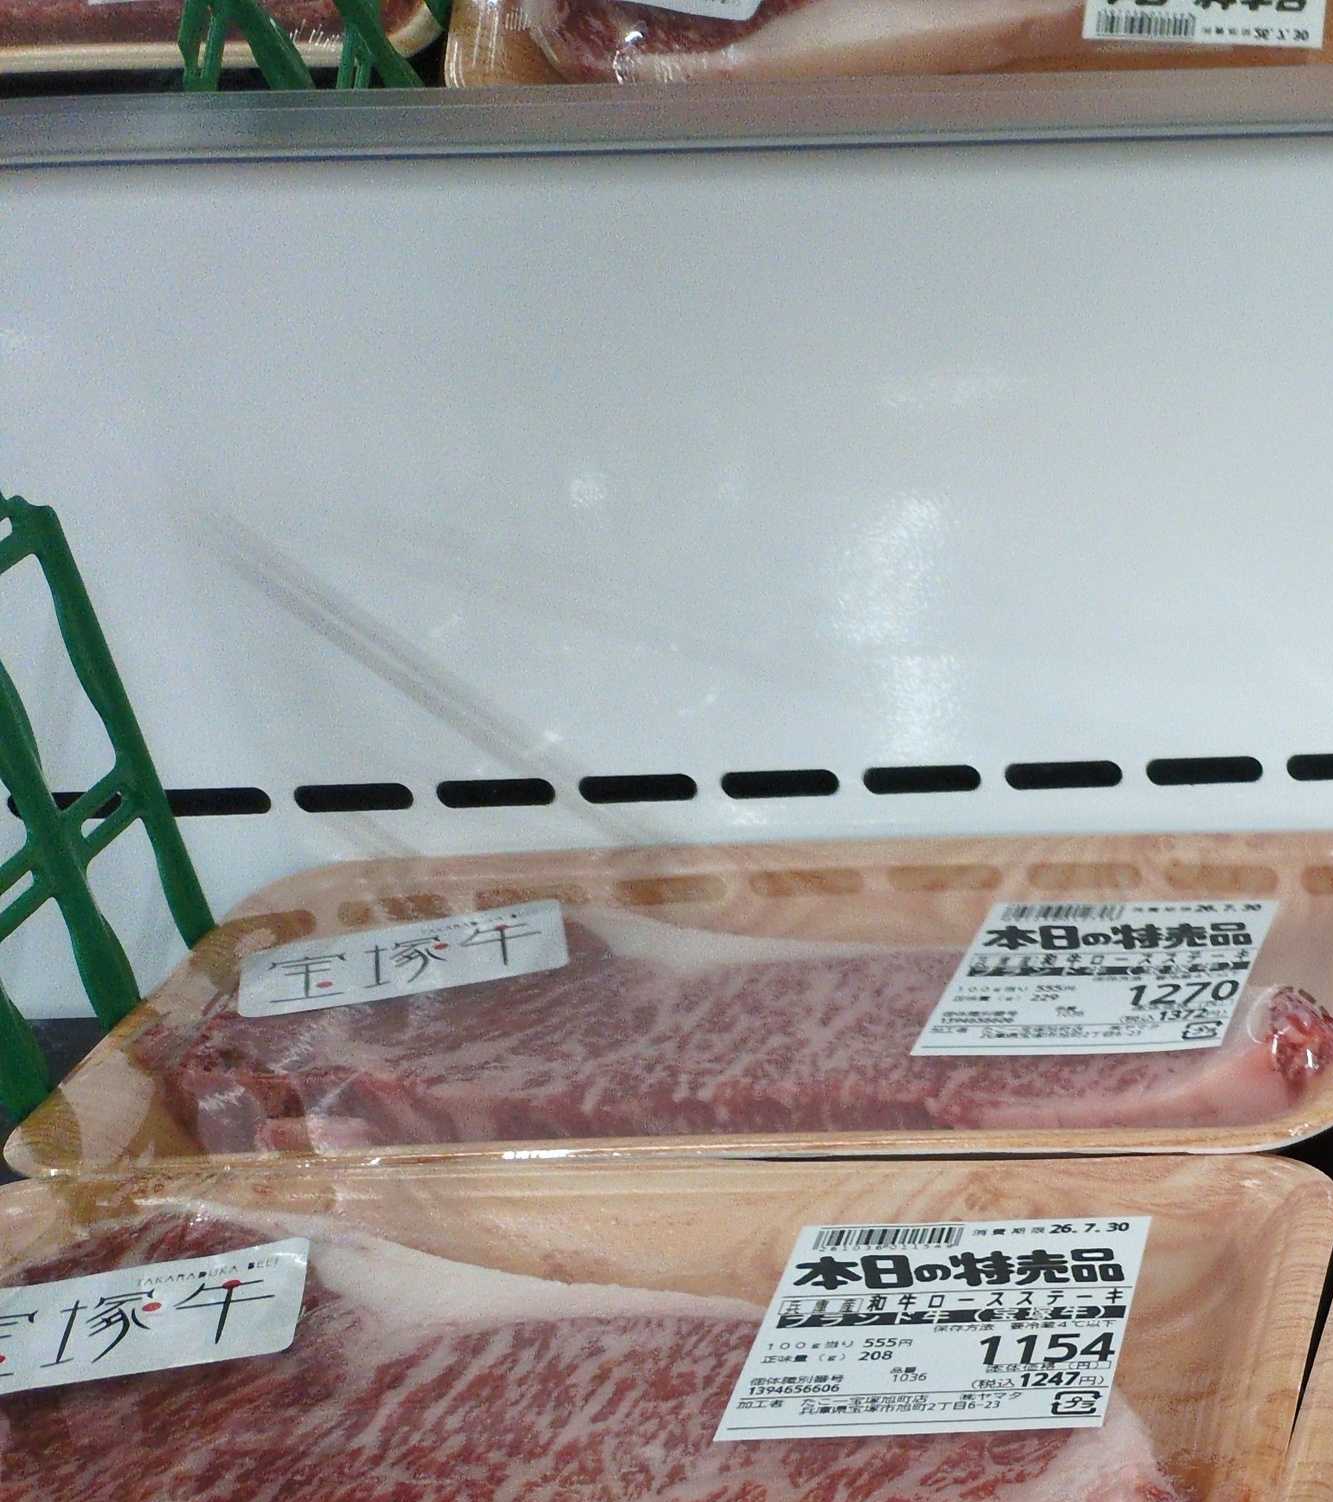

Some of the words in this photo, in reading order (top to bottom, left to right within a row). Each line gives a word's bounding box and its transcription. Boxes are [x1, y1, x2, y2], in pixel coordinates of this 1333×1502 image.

[984, 922, 1253, 951] 本日の特売品
[269, 924, 541, 1003] 宝塚牛
[1129, 979, 1240, 1008] 1270
[1048, 1221, 1130, 1235] 26.7.30
[792, 1247, 1126, 1291] 本日の特売品
[858, 1350, 893, 1361] 208
[980, 1332, 1116, 1366] 1154
